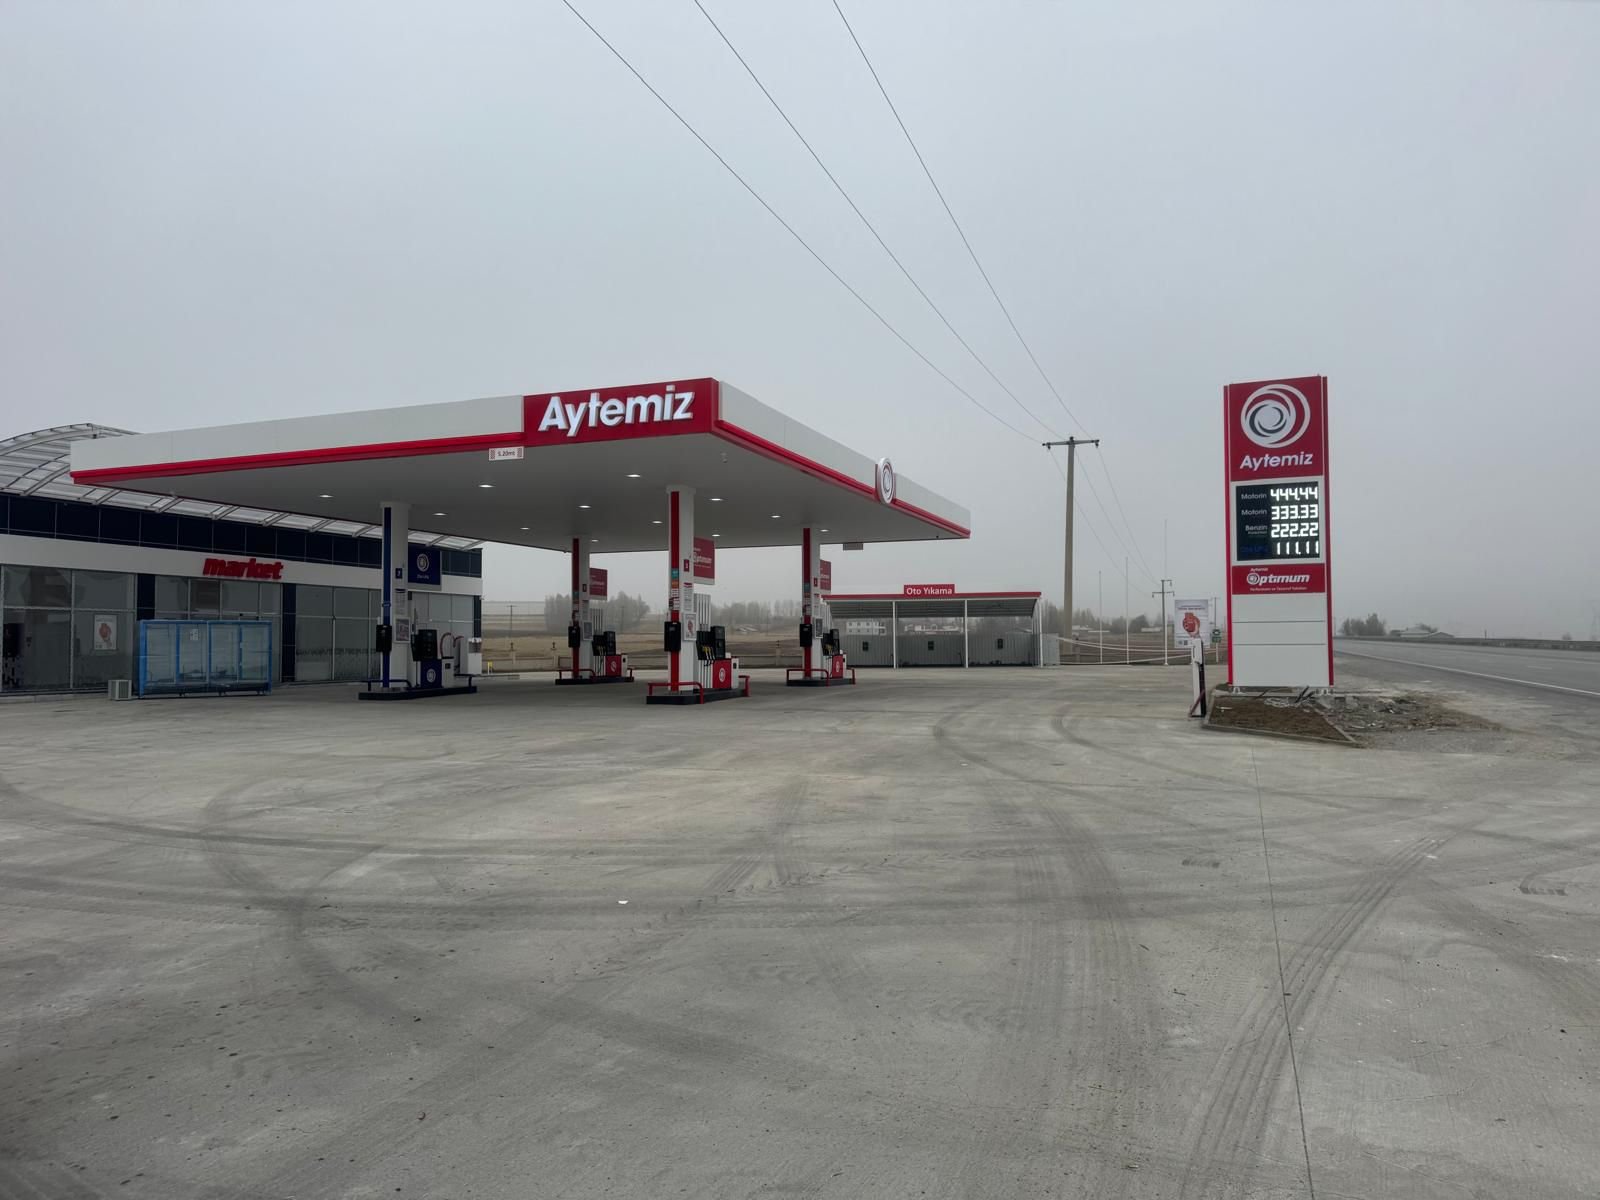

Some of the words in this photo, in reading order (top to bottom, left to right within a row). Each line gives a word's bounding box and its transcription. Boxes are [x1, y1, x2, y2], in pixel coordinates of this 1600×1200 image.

[538, 385, 695, 437] Aytemiz
[1239, 452, 1314, 471] Aytemiz
[1241, 492, 1267, 500] Motorin
[1270, 486, 1318, 502] 444.44
[1271, 504, 1319, 520] 333.33
[1245, 524, 1267, 532] Benzin
[1271, 522, 1319, 538] 222.22
[203, 558, 284, 580] market
[906, 587, 921, 595] Oto
